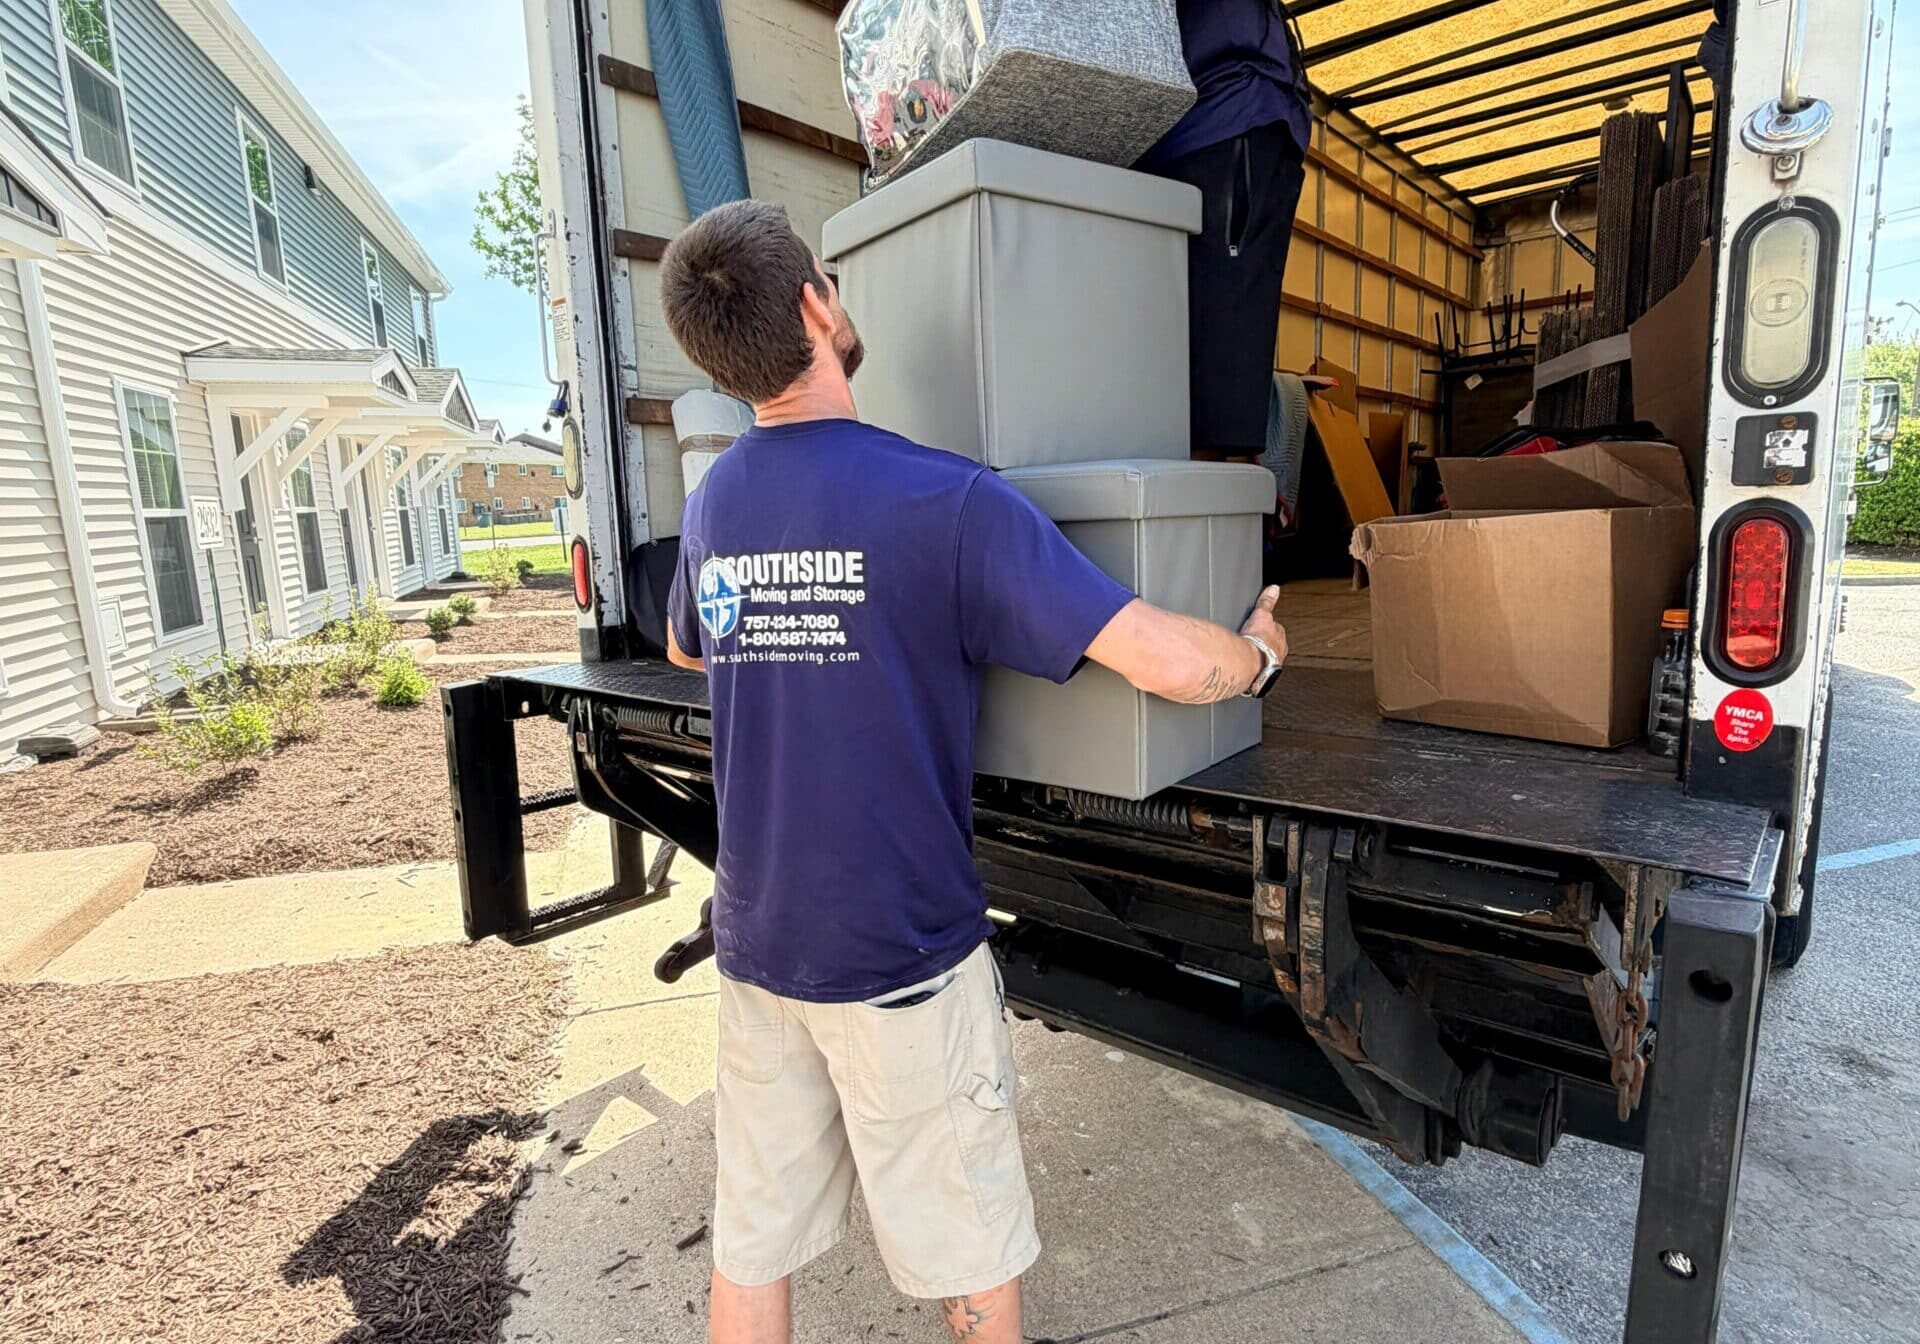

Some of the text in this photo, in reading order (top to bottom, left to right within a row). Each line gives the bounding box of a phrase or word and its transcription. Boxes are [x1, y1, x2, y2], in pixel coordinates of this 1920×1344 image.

[750, 585, 866, 605] Moving and Storage
[1725, 705, 1763, 721] YMCA
